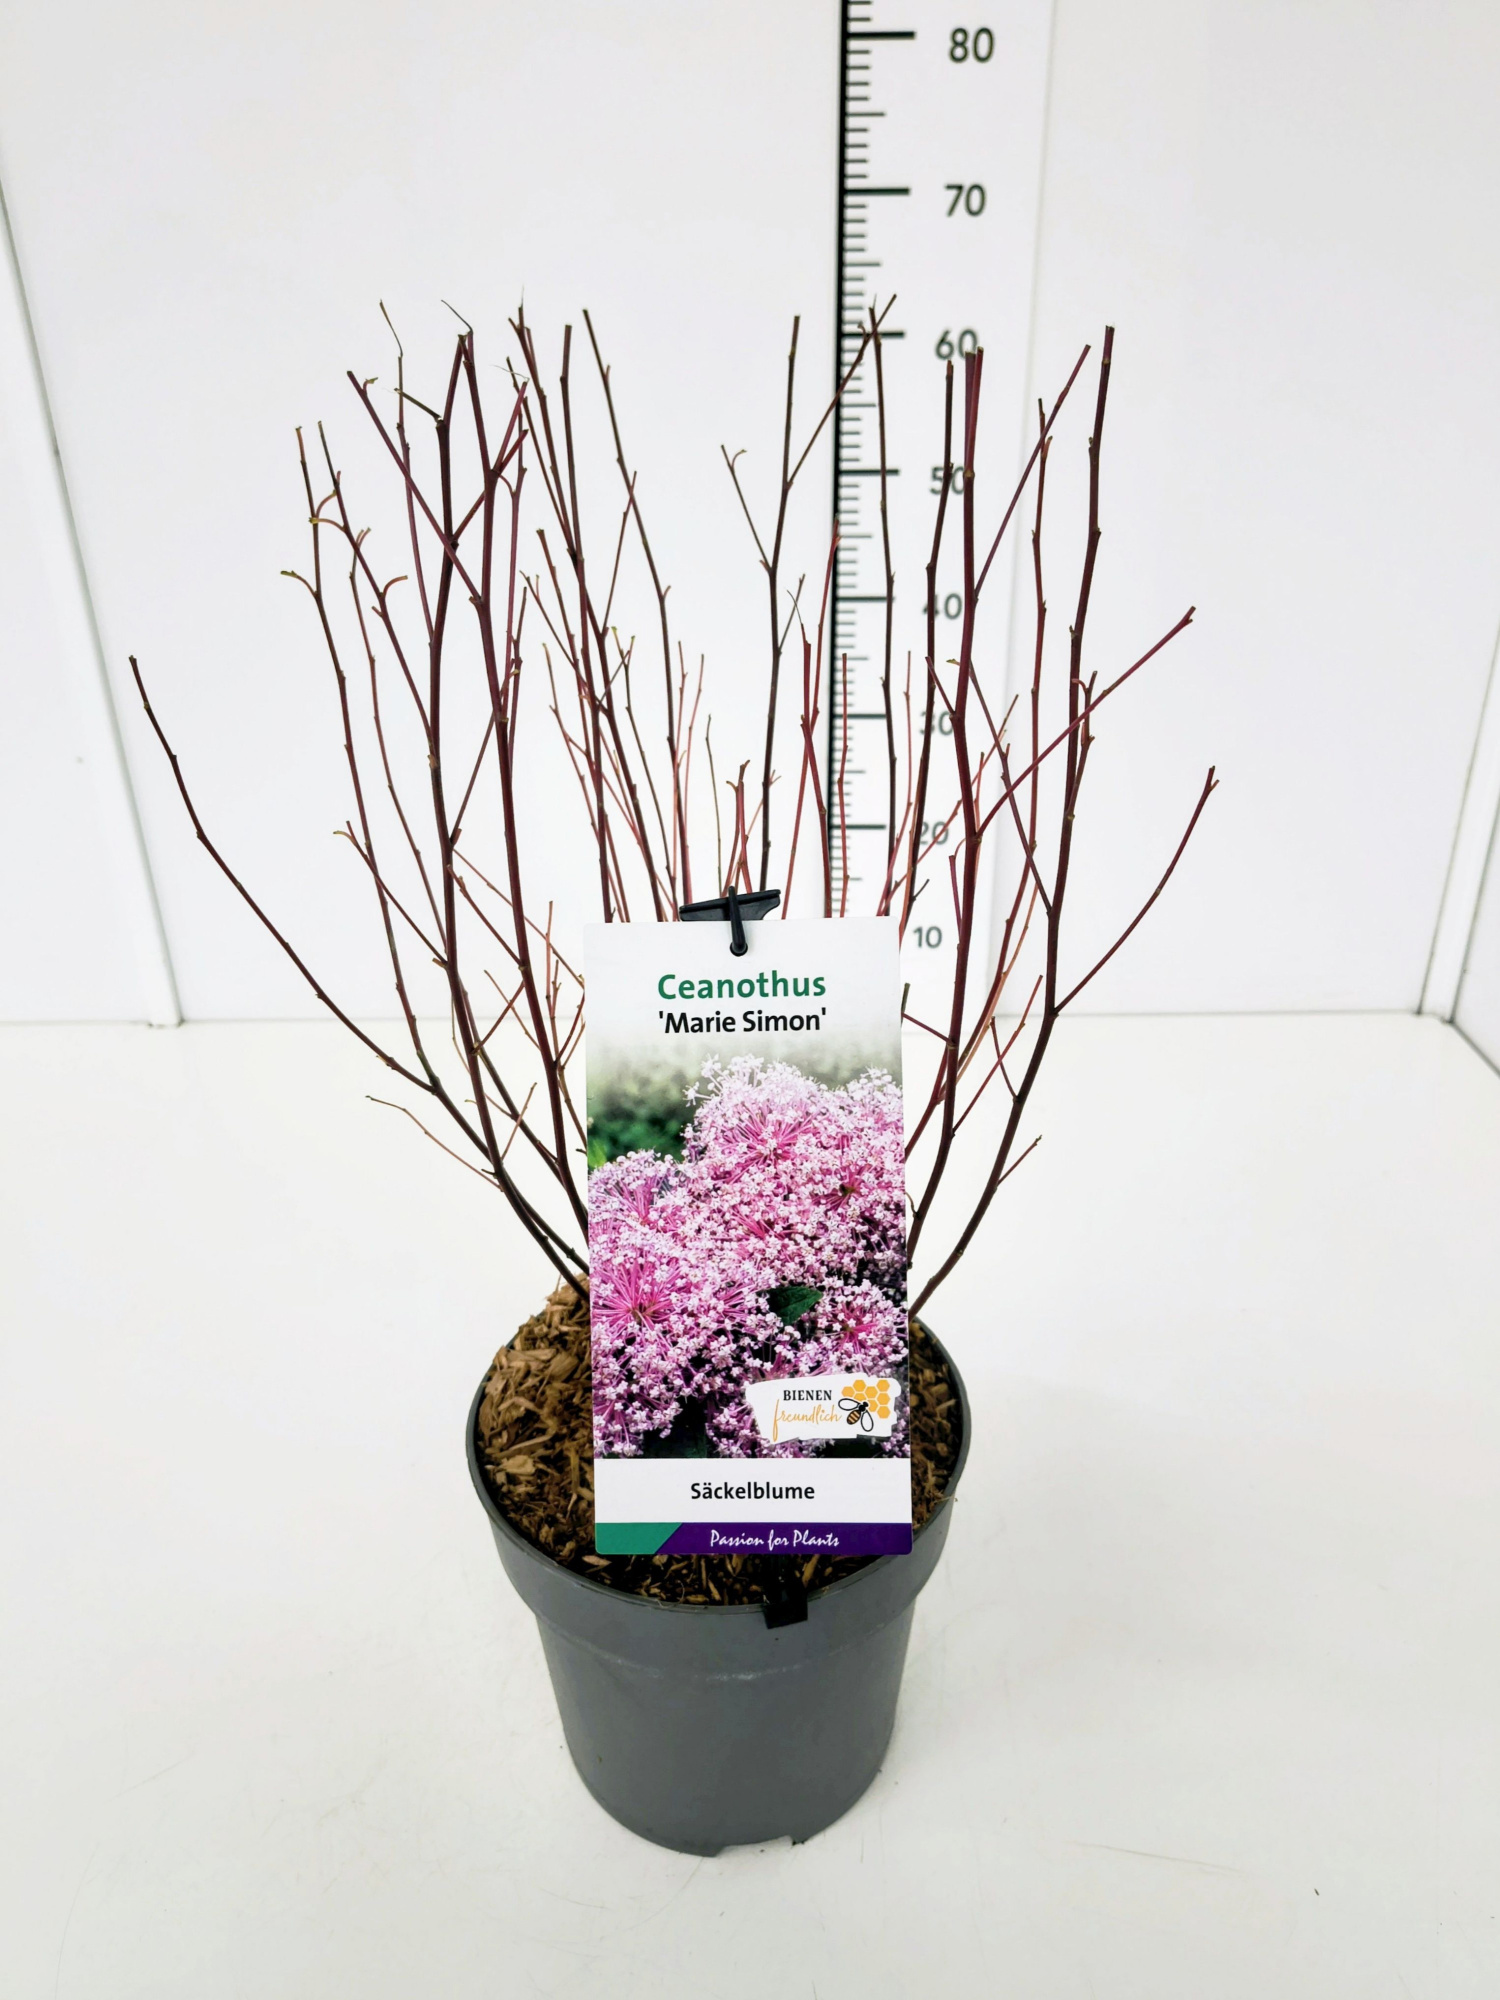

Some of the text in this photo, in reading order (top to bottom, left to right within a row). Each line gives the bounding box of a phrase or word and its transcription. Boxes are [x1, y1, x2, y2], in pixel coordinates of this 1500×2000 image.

[949, 27, 994, 63] 80
[944, 184, 987, 217] 70
[935, 329, 978, 361] 60
[929, 466, 968, 495] 50
[918, 821, 949, 845] 20
[913, 926, 943, 948] 10
[657, 970, 827, 1000] Ceanothus
[658, 1006, 828, 1034] 'Marie Simon'
[783, 1389, 833, 1401] BIENEN
[772, 1398, 842, 1442] freundlich
[690, 1481, 816, 1500] Säckelblume
[710, 1529, 840, 1551] Passion for Plants
